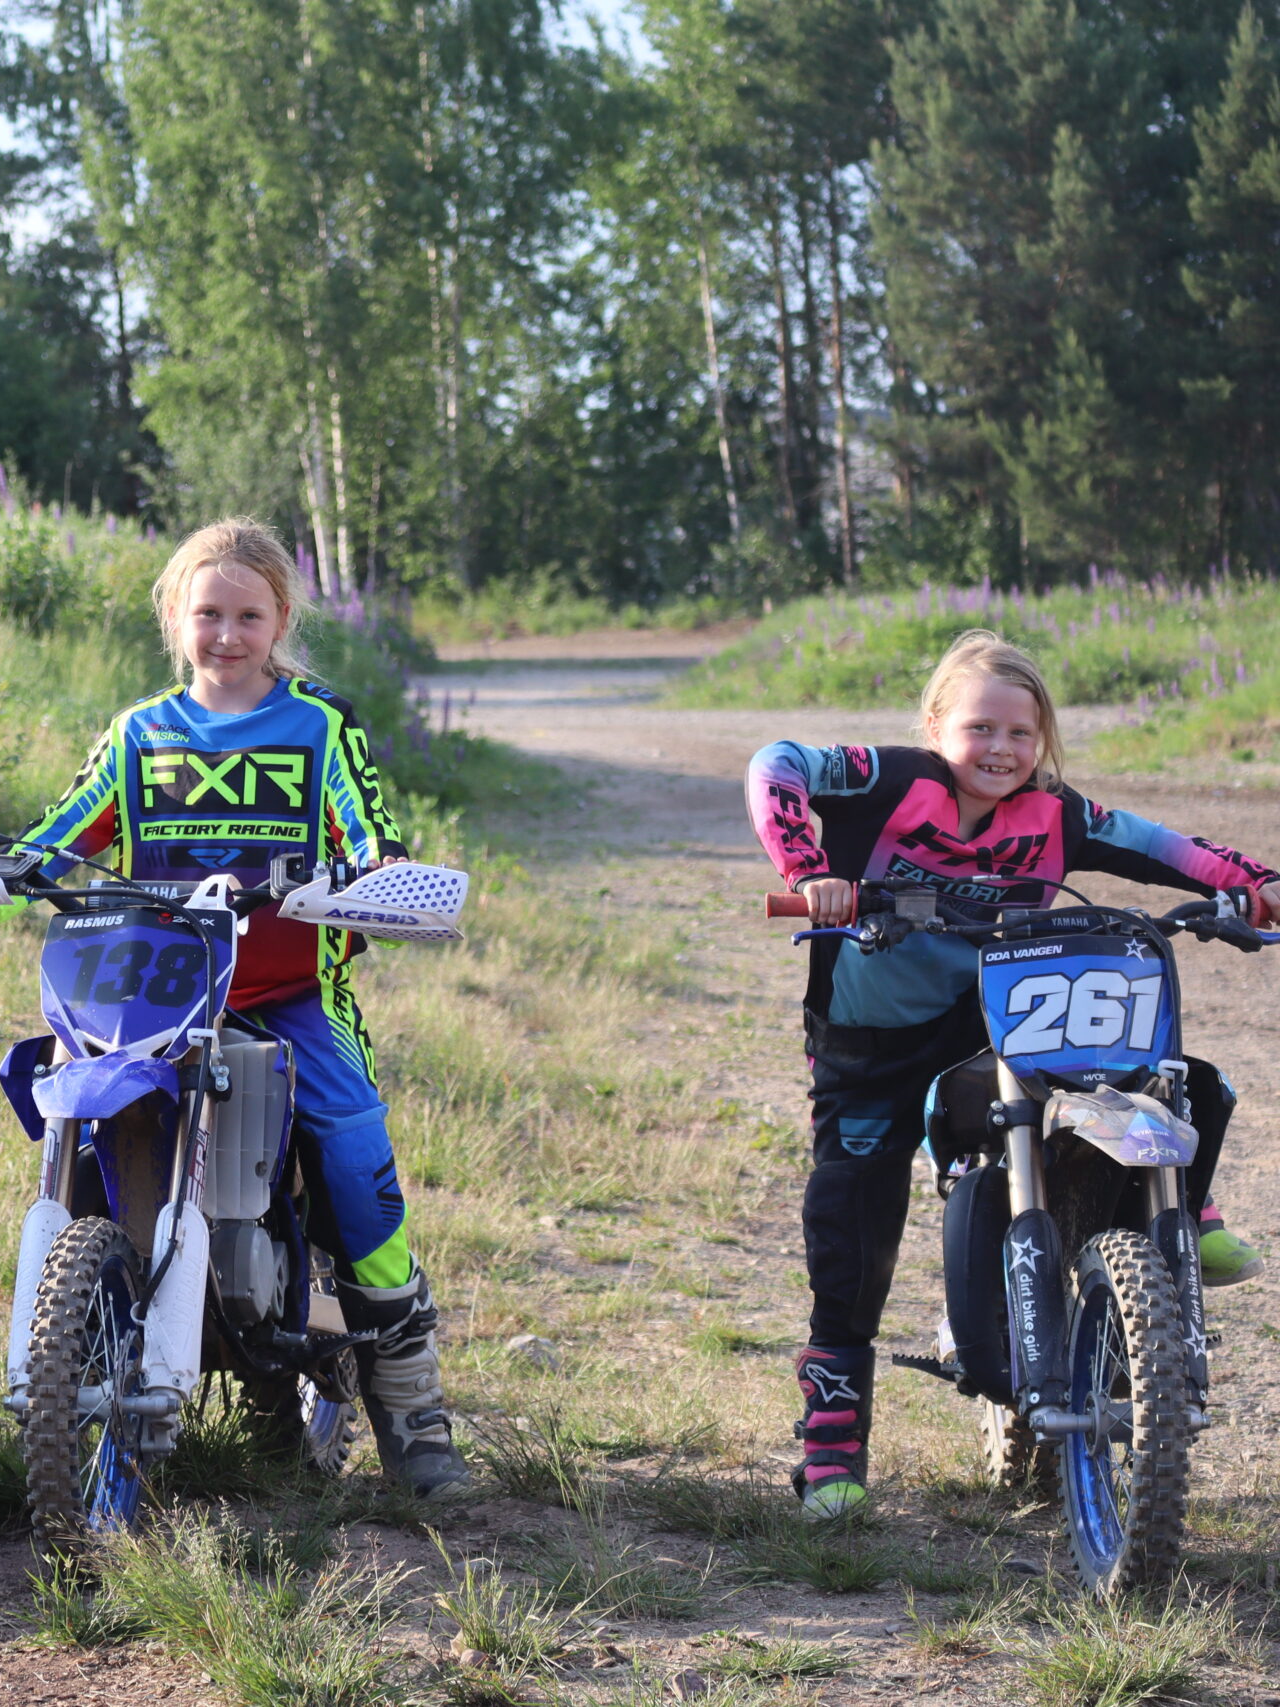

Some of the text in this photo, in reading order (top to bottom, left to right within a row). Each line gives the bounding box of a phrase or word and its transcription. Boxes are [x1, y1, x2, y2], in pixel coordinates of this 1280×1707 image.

[158, 723, 192, 736] RACE
[141, 753, 305, 808] FXR
[143, 823, 303, 838] FACTORY RACING
[120, 885, 178, 900] MAHA
[64, 914, 126, 930] RASMUS
[1051, 916, 1090, 927] YAMAHA
[985, 944, 1064, 963] ODA VANGEN
[70, 940, 207, 1009] 138
[1002, 968, 1163, 1057] 261
[1187, 1266, 1199, 1297] bike
[1019, 1273, 1041, 1362] dirt bike girls
[1191, 1299, 1202, 1325] dirt
